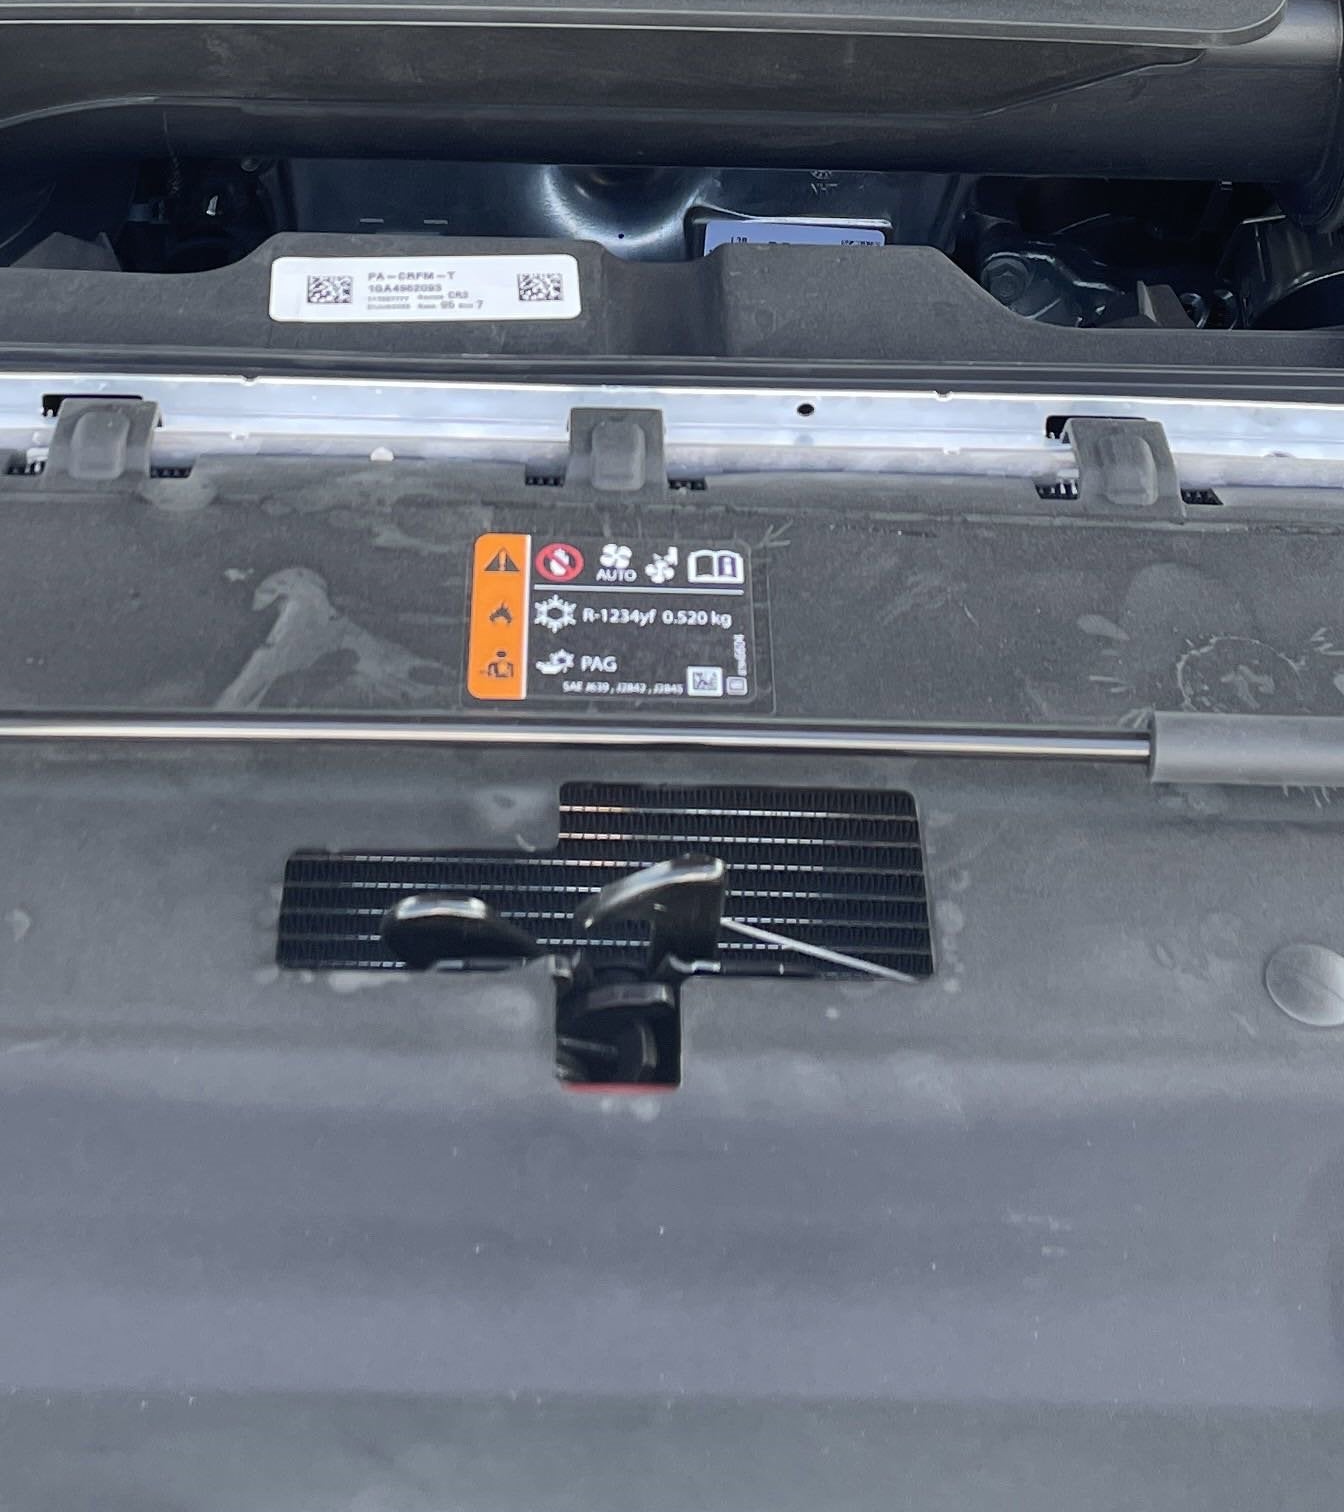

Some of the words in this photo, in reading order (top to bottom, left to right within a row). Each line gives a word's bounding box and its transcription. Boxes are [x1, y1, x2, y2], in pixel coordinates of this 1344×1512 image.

[596, 568, 638, 582] AUTO
[582, 607, 657, 627] R-1234yf
[662, 609, 707, 625] 0.520
[710, 610, 733, 629] kg
[580, 655, 618, 672] PAG
[562, 681, 582, 693] SAE
